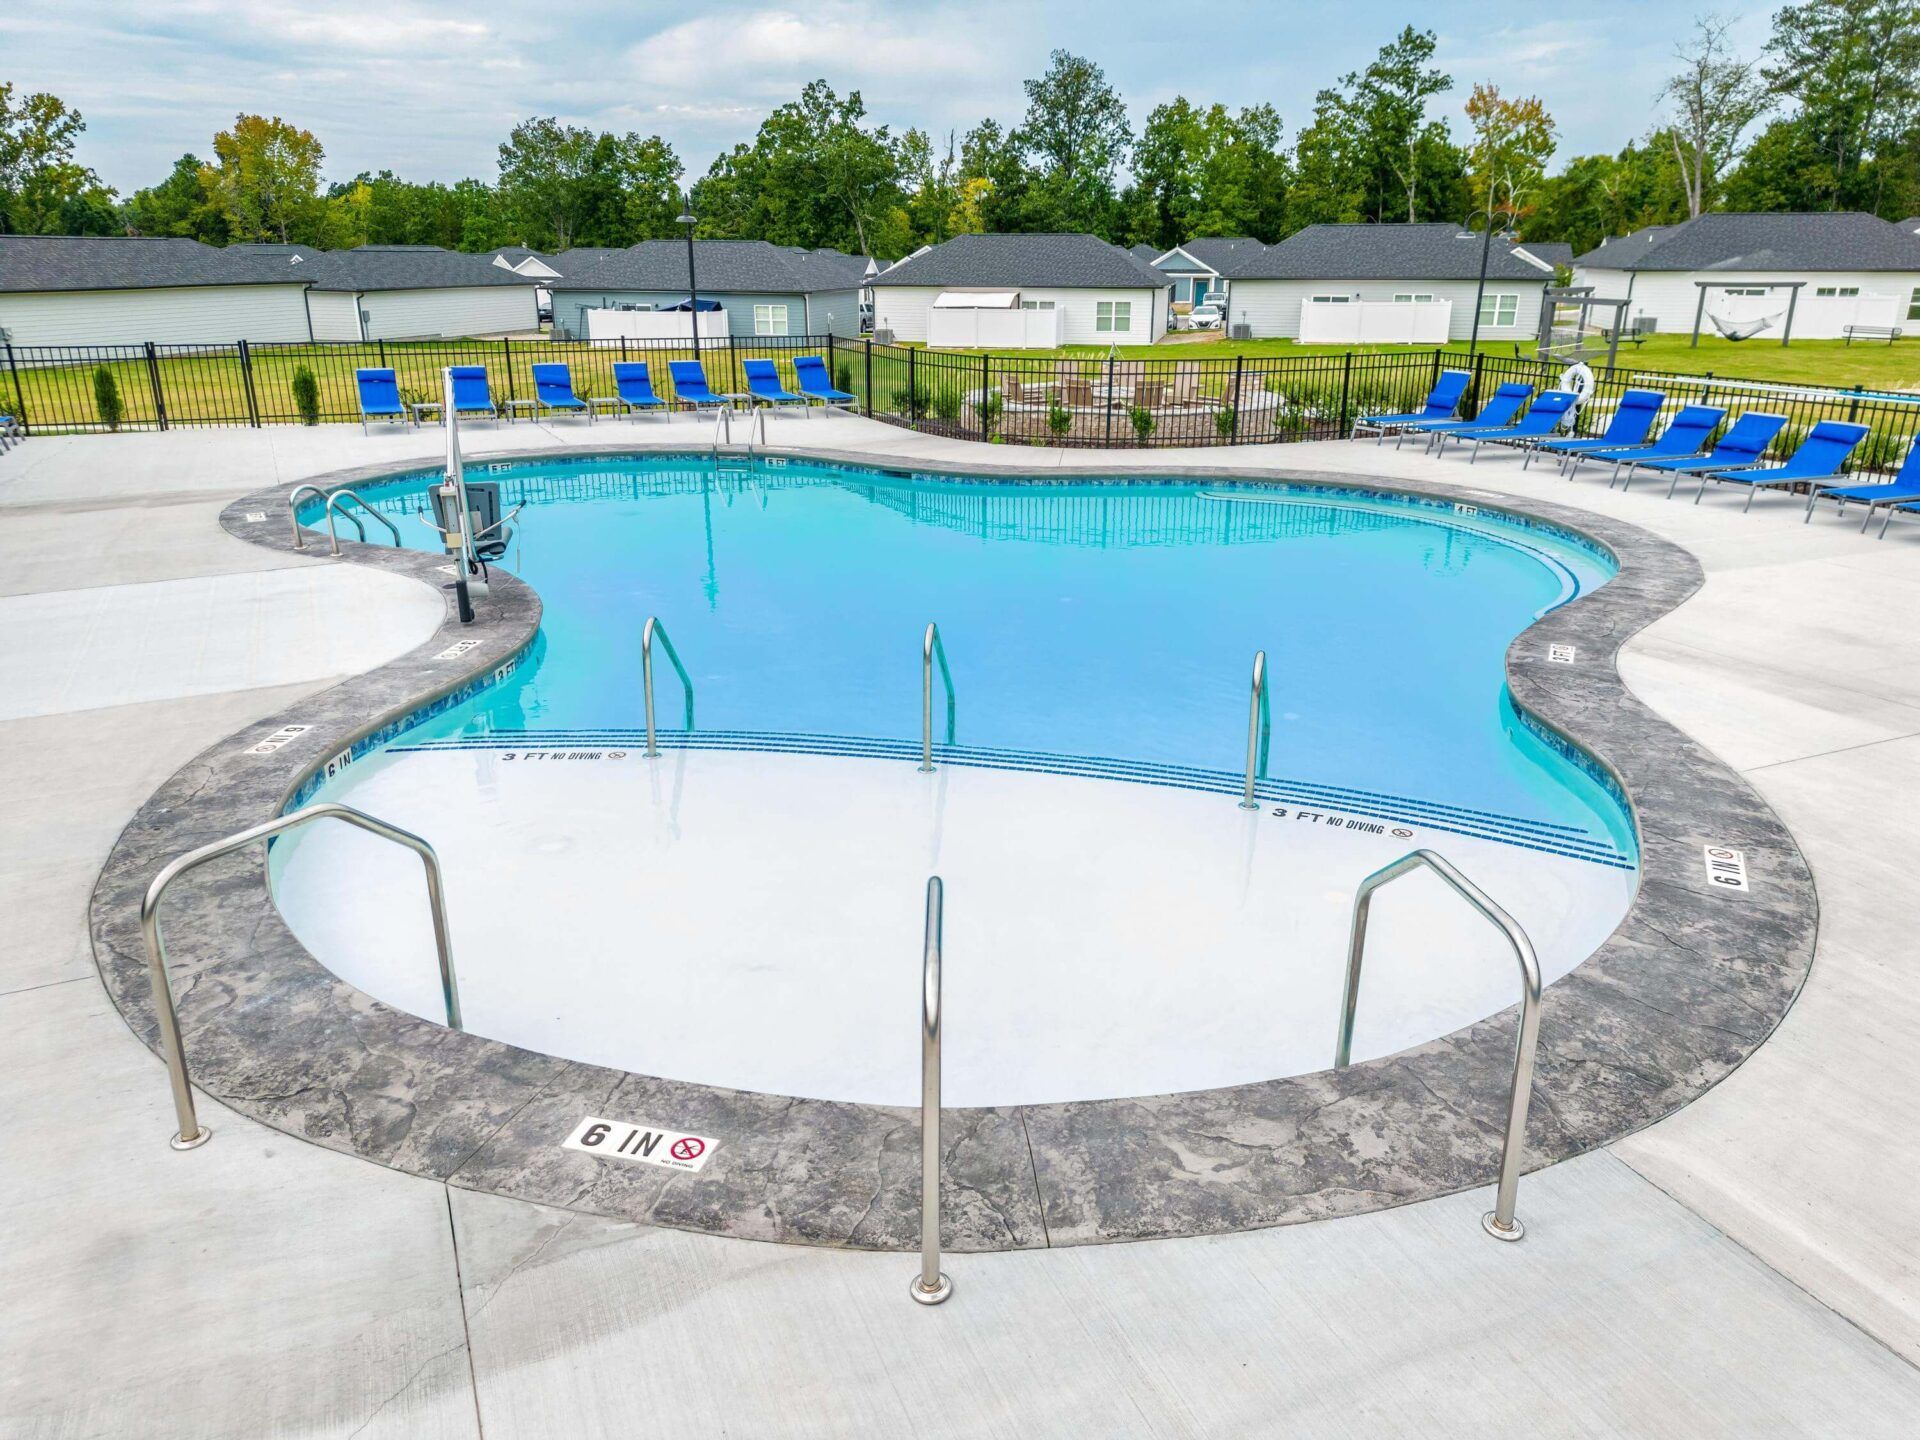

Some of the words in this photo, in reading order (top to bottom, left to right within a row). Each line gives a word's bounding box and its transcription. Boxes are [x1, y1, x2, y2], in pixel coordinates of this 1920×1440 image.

[498, 670, 504, 681] 3
[506, 661, 515, 675] FT
[265, 735, 294, 743] IN
[328, 763, 335, 777] 6
[339, 752, 351, 769] IN
[502, 753, 517, 761] 3
[523, 753, 549, 761] FT
[567, 752, 602, 760] DIVING
[1272, 808, 1288, 817] 3
[1296, 811, 1324, 823] FT
[1326, 816, 1344, 827] NO
[1346, 820, 1385, 835] DIVING
[1712, 860, 1741, 875] IN
[1713, 876, 1741, 886] 6
[580, 1123, 612, 1146] 6
[617, 1129, 664, 1157] IN
